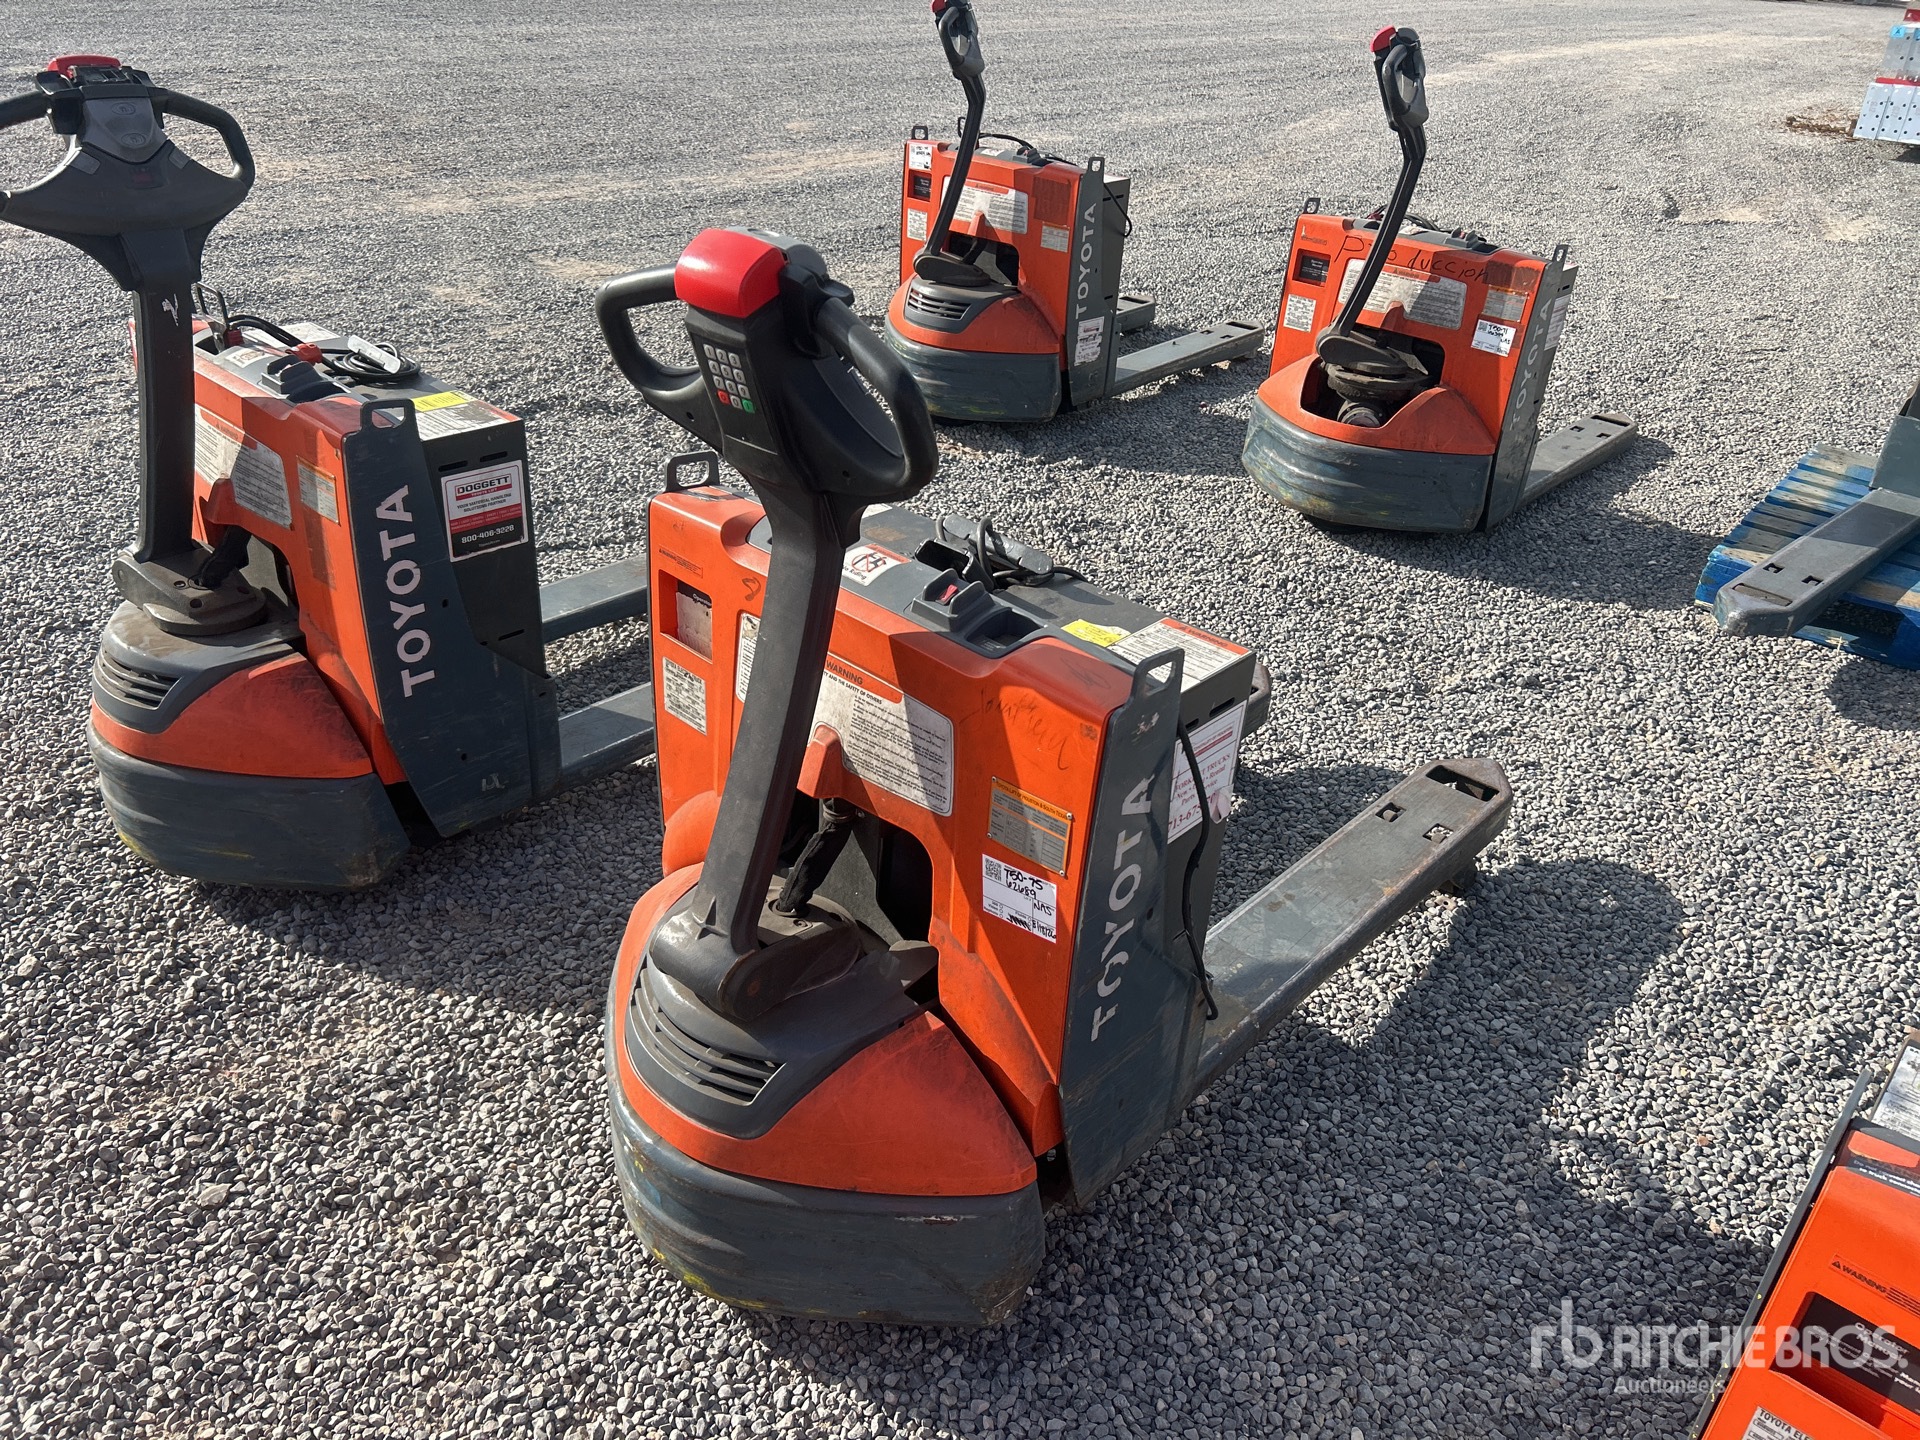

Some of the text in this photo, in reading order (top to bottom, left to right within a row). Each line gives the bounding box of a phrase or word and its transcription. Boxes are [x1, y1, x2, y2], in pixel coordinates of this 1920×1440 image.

[1075, 202, 1097, 320] TOYOTA
[457, 476, 509, 494] DOGGETT
[849, 568, 867, 580] Riding
[375, 484, 436, 698] TOYOTA
[826, 659, 864, 685] WARNING
[828, 674, 838, 682] AND
[845, 682, 860, 694] SAFETY
[866, 693, 882, 705] OTHERS
[1006, 879, 1037, 900] 62689
[1090, 773, 1155, 1043] TOYOTA
[1868, 1170, 1888, 1181] truck
[1842, 1265, 1887, 1294] WARNING
[1855, 1322, 1910, 1354] Operator
[1856, 1333, 1904, 1361] Manual
[1894, 1376, 1914, 1390] your
[1759, 1408, 1792, 1434] TOYOTA
